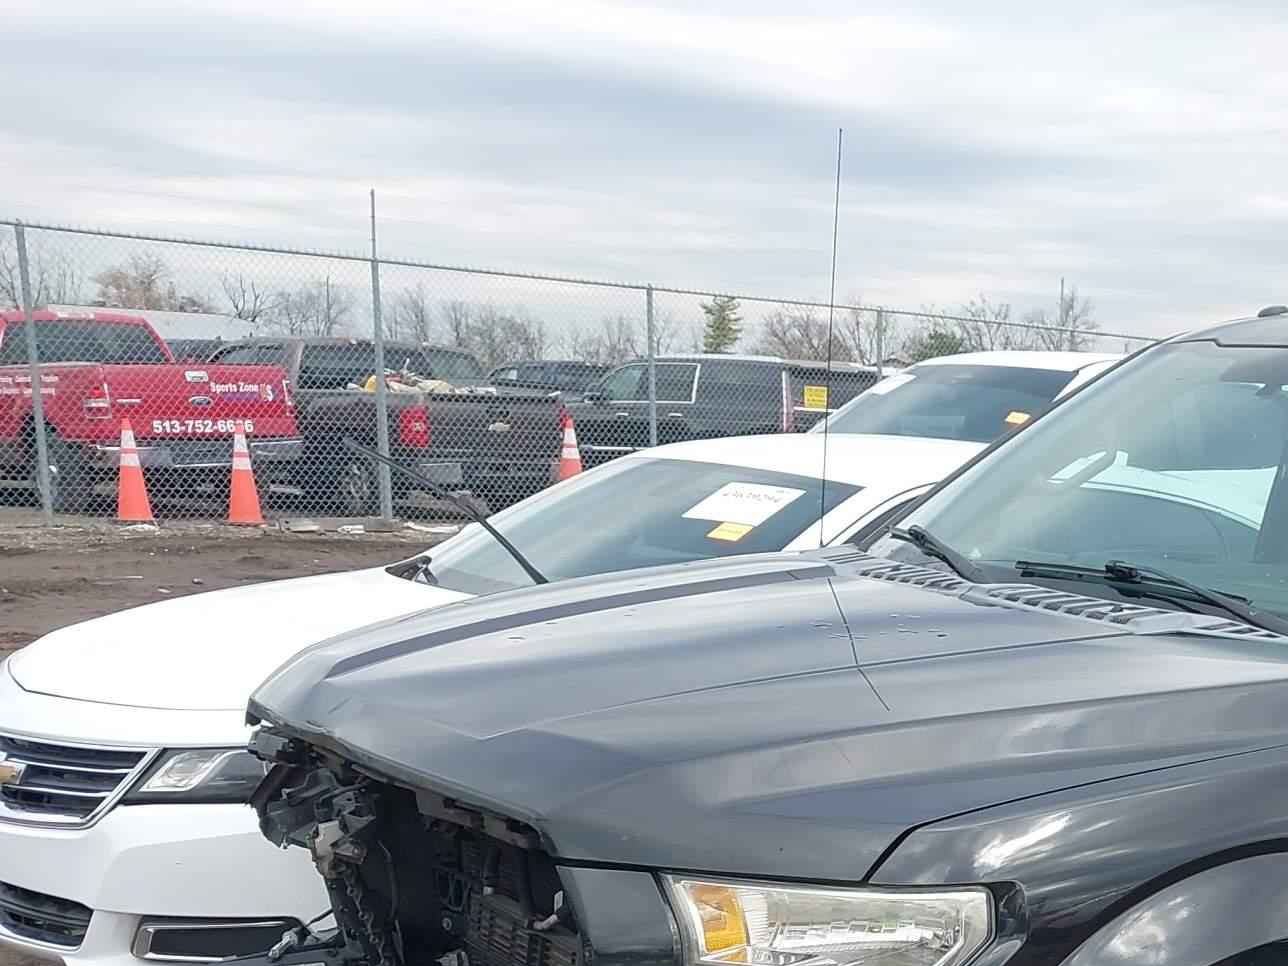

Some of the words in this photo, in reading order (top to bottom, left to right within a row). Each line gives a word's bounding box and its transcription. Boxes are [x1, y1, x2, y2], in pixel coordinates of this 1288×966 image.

[210, 382, 238, 394] Sports
[239, 382, 259, 392] Zone
[152, 420, 254, 433] 513-752-666
